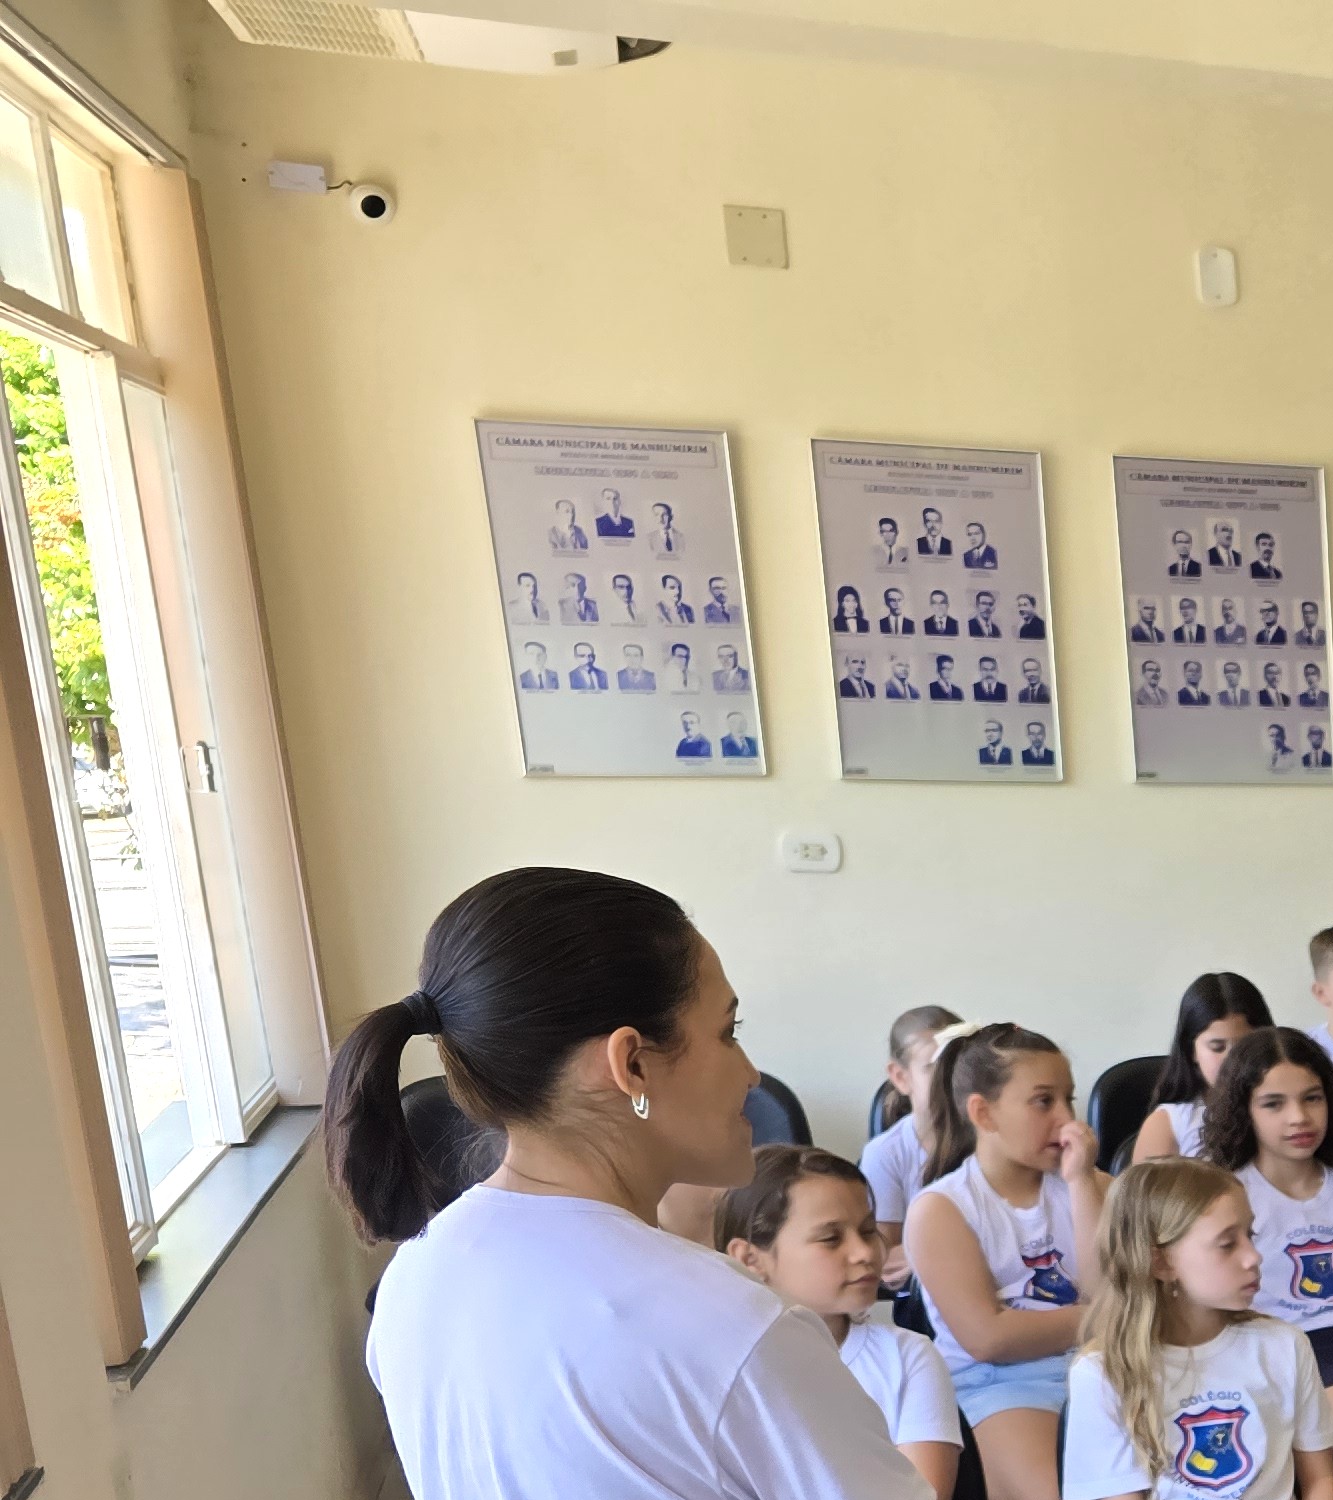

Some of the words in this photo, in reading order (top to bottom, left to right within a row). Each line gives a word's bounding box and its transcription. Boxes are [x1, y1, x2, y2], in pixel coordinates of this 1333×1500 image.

[546, 439, 610, 451] MUNICIPAL
[612, 442, 628, 451] DE
[1179, 1390, 1242, 1406] COLÉGIO
